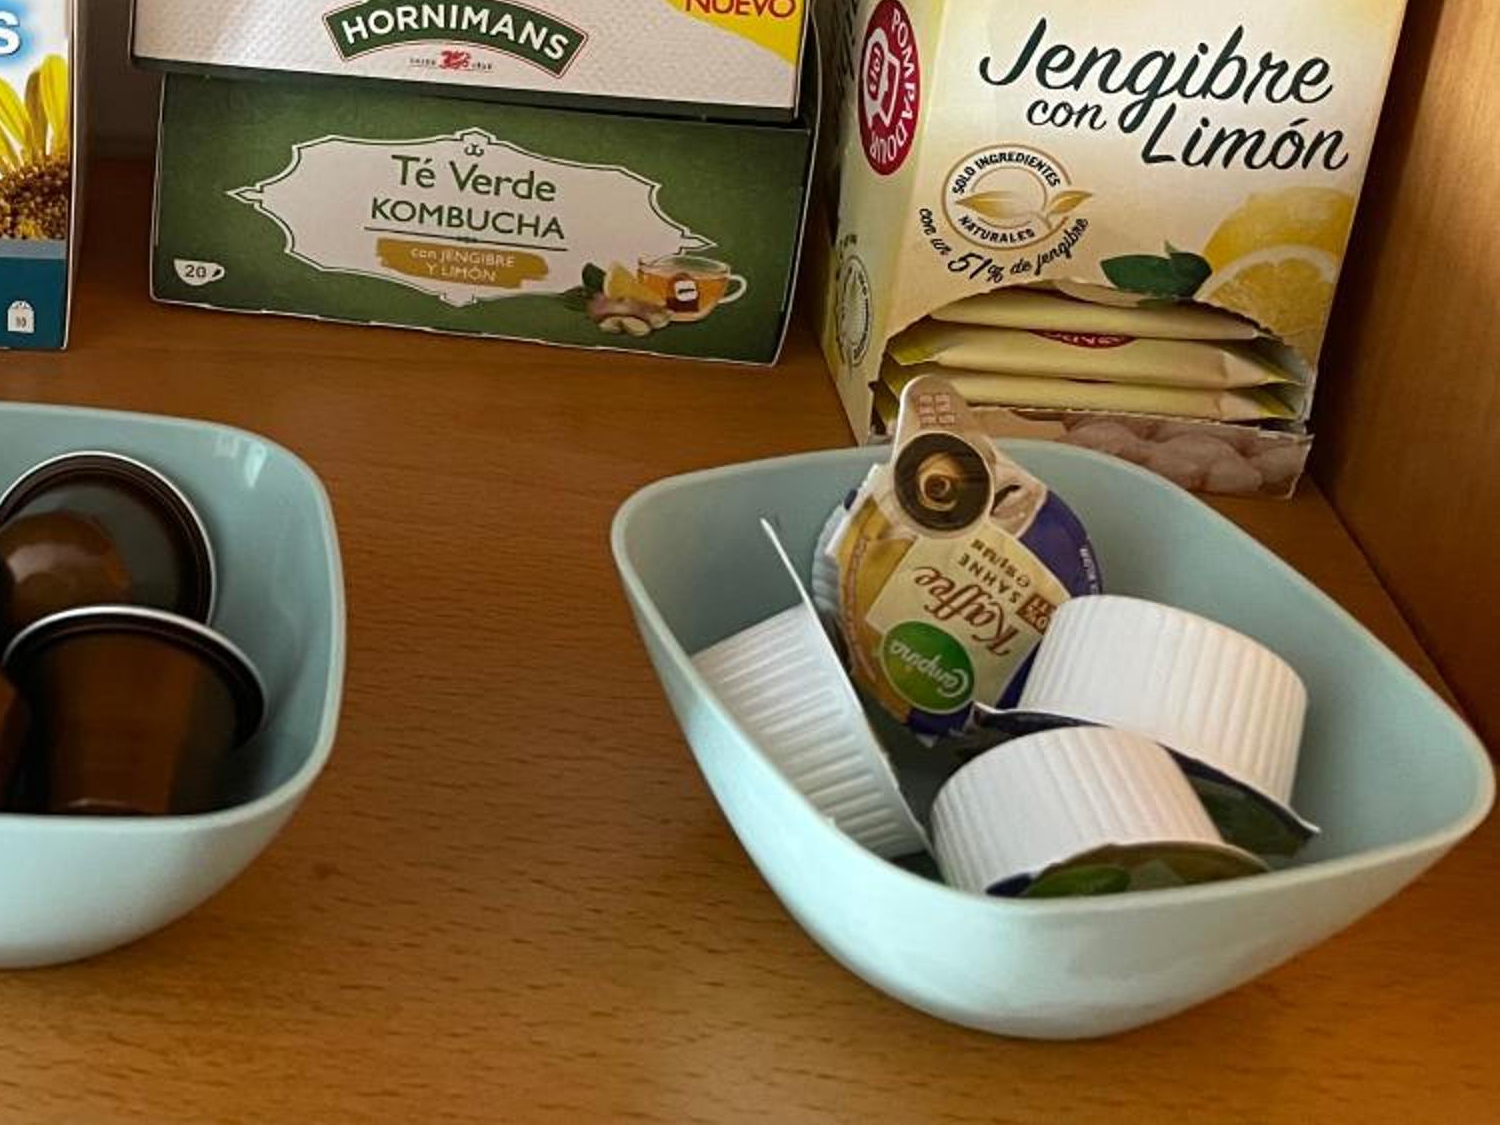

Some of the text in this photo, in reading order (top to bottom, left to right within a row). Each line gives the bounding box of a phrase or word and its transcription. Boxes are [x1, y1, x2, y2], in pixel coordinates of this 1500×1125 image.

[341, 4, 569, 60] HORNIMANS
[870, 8, 916, 164] POMPADOUR
[979, 17, 1334, 133] Jengibre
[1025, 96, 1350, 171] con Limón
[391, 154, 557, 202] Té Verde
[952, 151, 1061, 195] SOLO INGREDIENTES
[371, 197, 565, 240] KOMBUCHA
[919, 208, 936, 235] con
[1010, 259, 1033, 275] de
[958, 215, 1035, 244] NATURALES
[185, 264, 207, 278] 20
[411, 248, 516, 267] con JENGIBRE
[427, 263, 437, 275] Y
[958, 553, 1020, 604] SAHNE
[914, 566, 1019, 656] Kaffee
